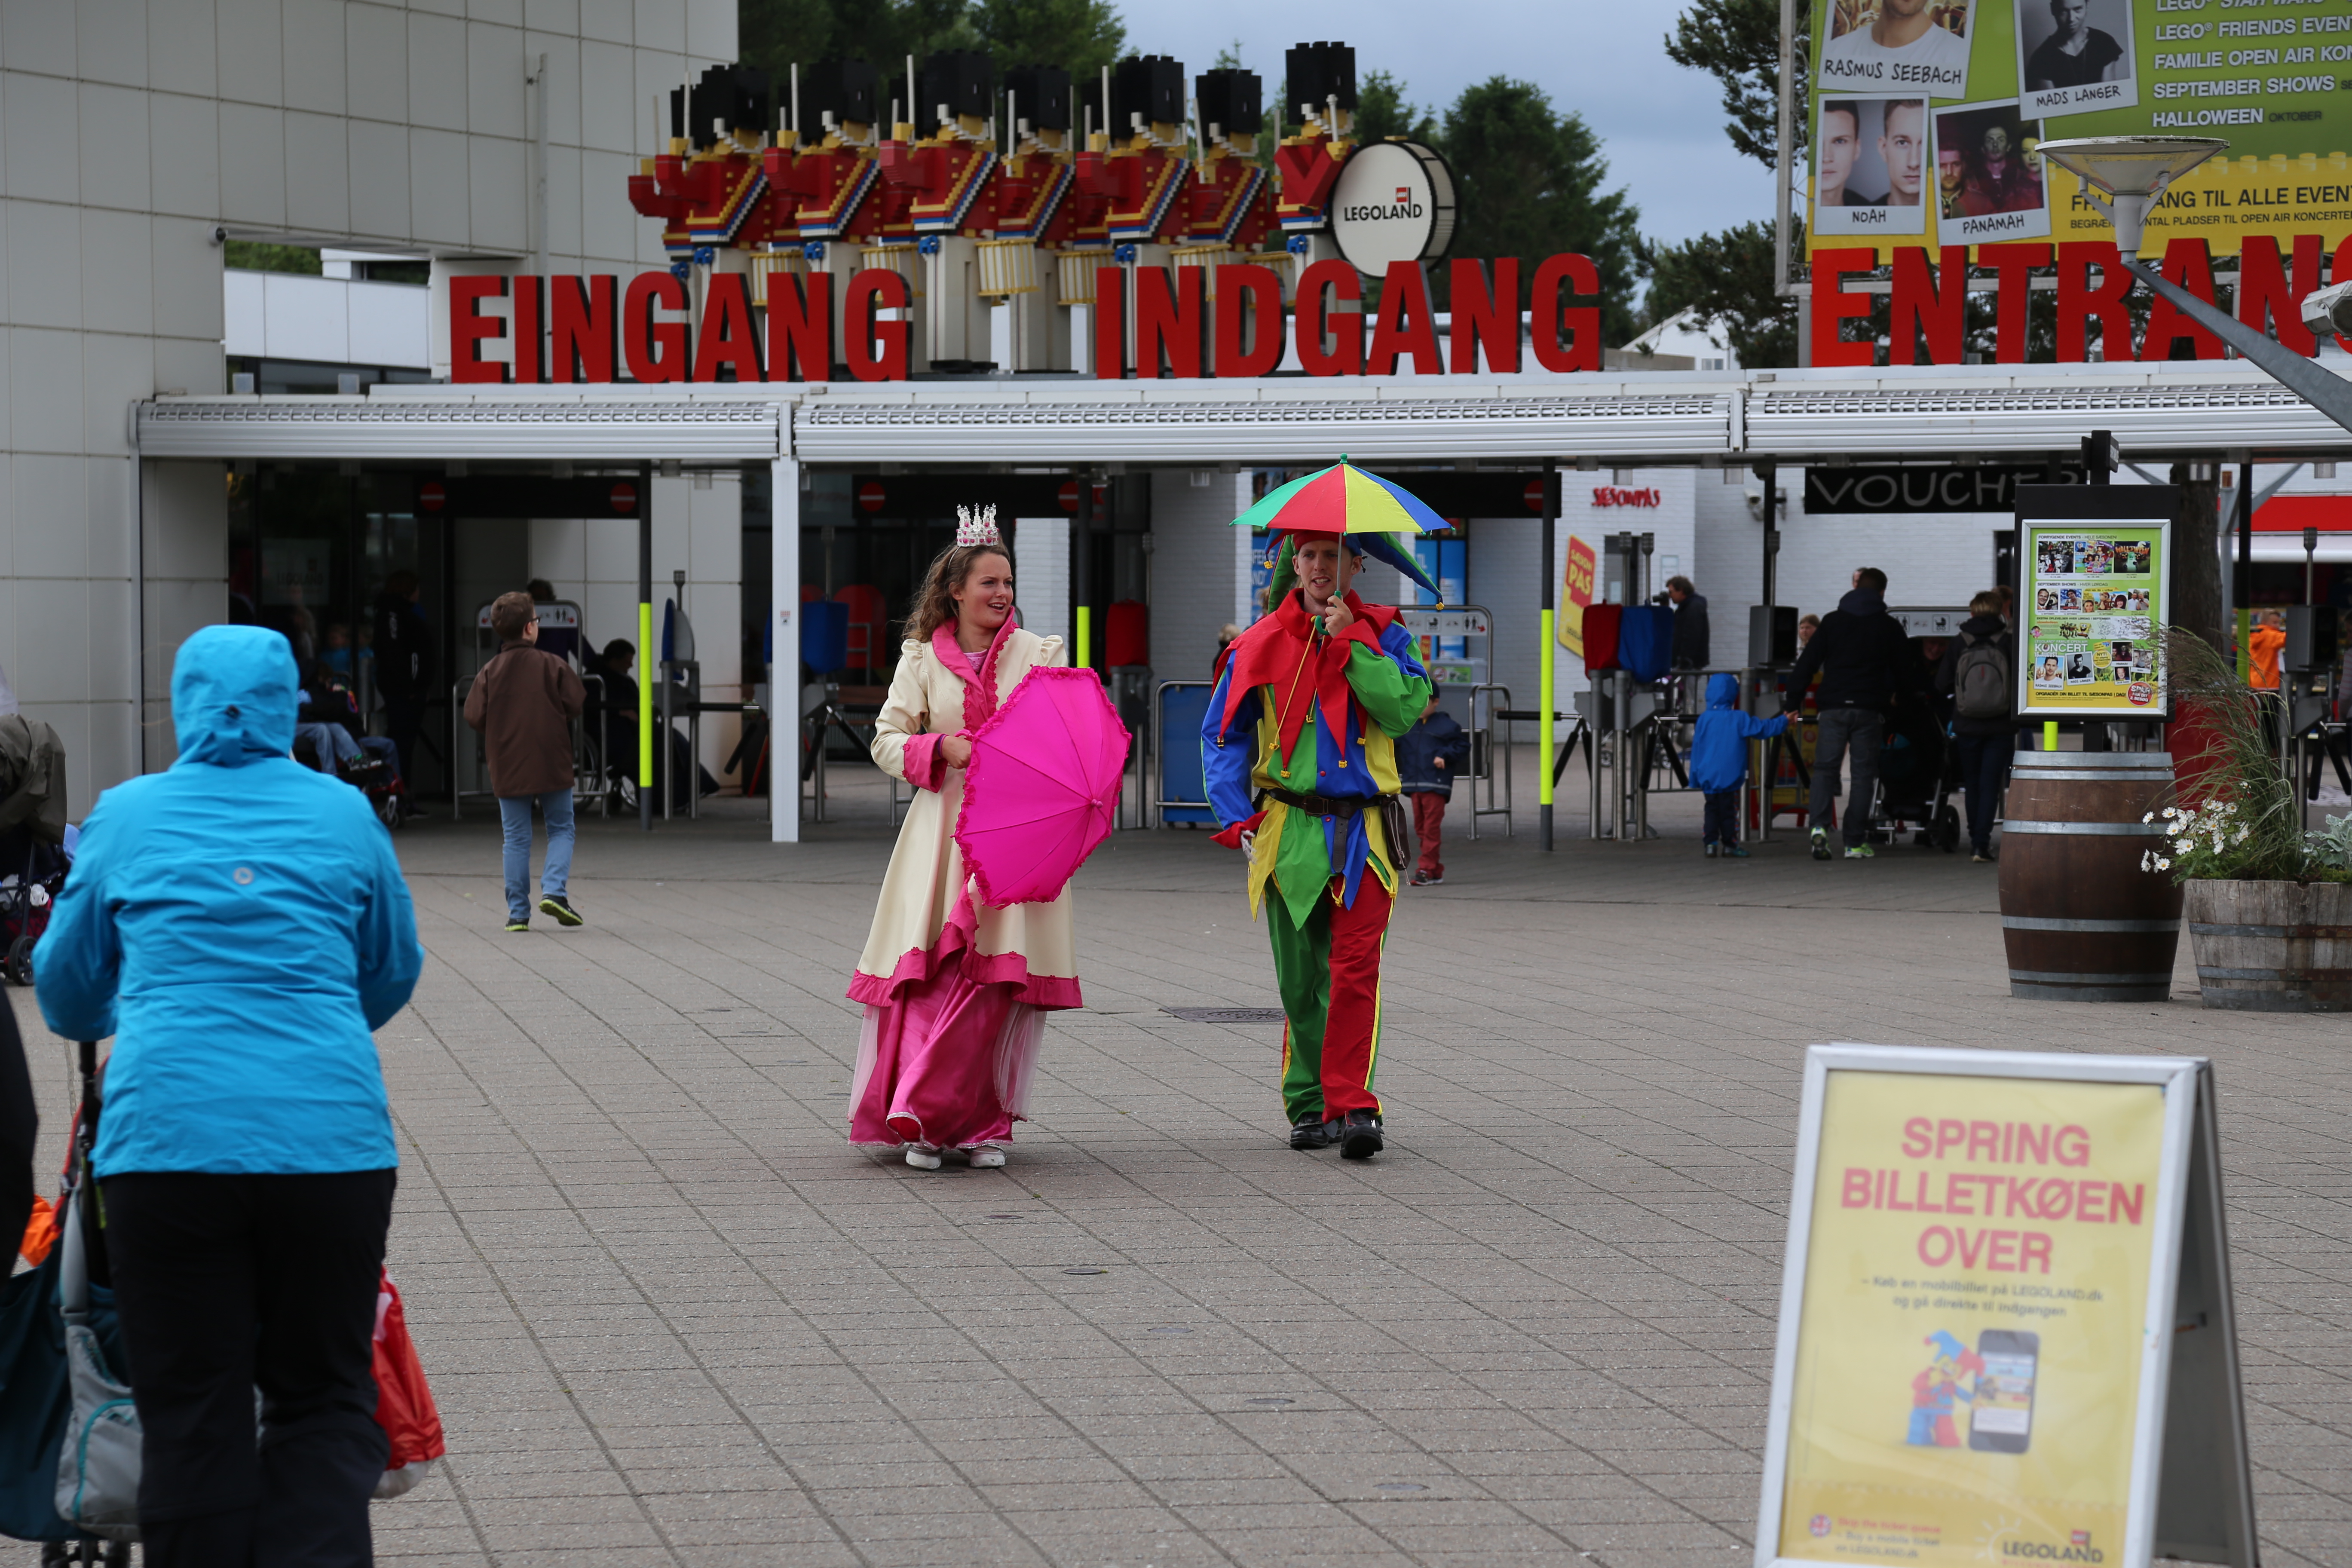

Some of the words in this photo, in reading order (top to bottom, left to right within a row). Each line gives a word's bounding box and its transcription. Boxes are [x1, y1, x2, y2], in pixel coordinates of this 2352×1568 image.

[2218, 18, 2296, 37] FRIENDS
[2302, 15, 2352, 33] EVEN
[2154, 52, 2223, 69] FAMILIE
[2228, 49, 2278, 66] OPEN
[2284, 47, 2315, 63] AIR
[1824, 59, 1883, 79] RASMUS
[1891, 63, 1962, 85] SEEBACH
[2036, 91, 2069, 107] MADS
[2075, 85, 2121, 102] LANGER
[2153, 79, 2261, 99] SEPTEMBER
[2266, 75, 2335, 94] SHOWS
[2153, 108, 2263, 127] HALLOWEEN
[2269, 111, 2322, 122] OKTOBER
[2203, 190, 2232, 207] TIL
[2238, 187, 2289, 206] ALLE
[2296, 185, 2352, 204] EVEN
[1344, 202, 1423, 221] LEGOLAND
[1852, 209, 1886, 224] NOAH
[2173, 215, 2220, 226] PLADSER
[2223, 215, 2238, 224] TIL
[2241, 214, 2270, 223] OPEN
[2273, 213, 2291, 222] AIR
[2294, 210, 2352, 221] KONCERTE
[1962, 214, 2025, 235] PANAMAH
[1811, 232, 2352, 368] ENTRAN
[450, 268, 912, 383] EINGANG
[1096, 252, 1604, 379] INDGANG
[1568, 562, 1592, 596] PAS
[2035, 643, 2088, 652] KONCERT
[1901, 1117, 2091, 1167] SPRING
[1841, 1167, 2145, 1225] BILLETKØEN
[1917, 1225, 2054, 1274] OVER
[1901, 1279, 1917, 1289] en
[1920, 1279, 1988, 1294] mobilbillet
[1991, 1282, 2009, 1298] på
[2012, 1285, 2104, 1302] LEGOLAND.dk
[1893, 1296, 1909, 1309] og
[1913, 1294, 1930, 1311] gå
[1932, 1296, 1979, 1311] direkte
[1982, 1298, 1994, 1311] til
[2003, 1540, 2104, 1563] LEGOLAND
